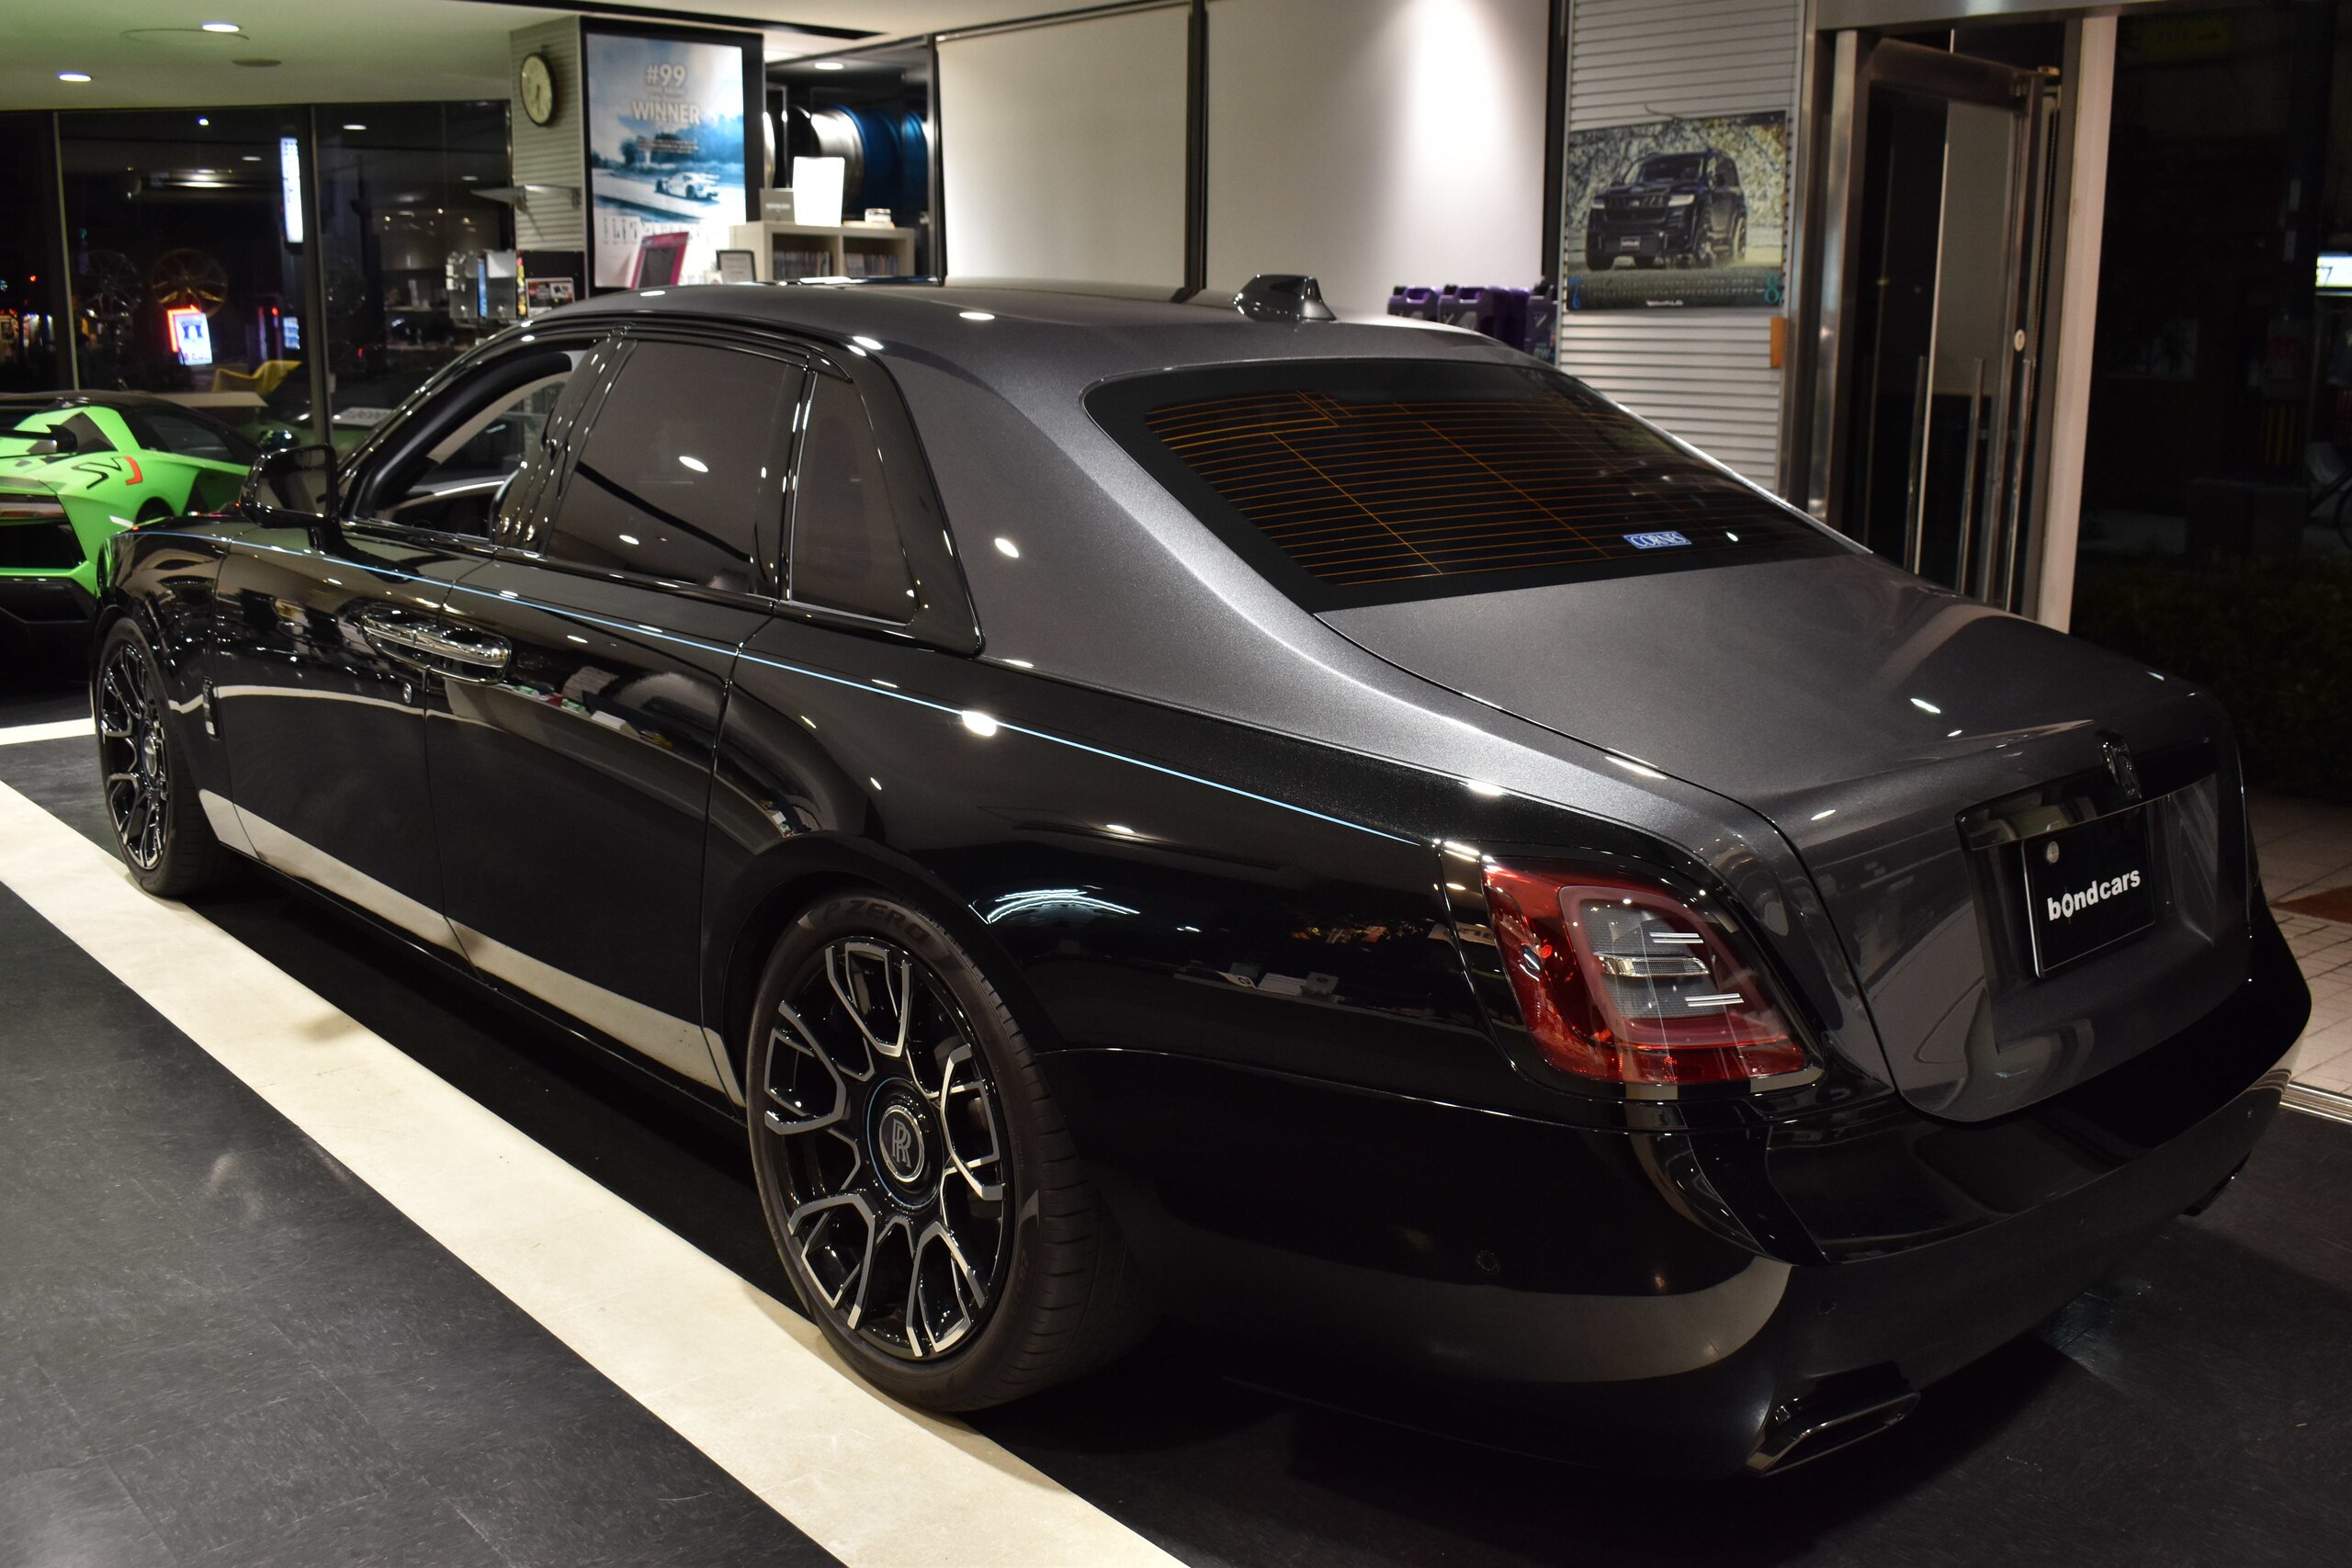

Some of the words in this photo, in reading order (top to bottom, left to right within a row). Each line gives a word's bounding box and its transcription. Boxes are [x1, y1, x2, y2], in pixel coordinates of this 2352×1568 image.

[646, 63, 686, 87] #99
[632, 100, 701, 125] WINNER
[1763, 272, 1781, 304] 8
[845, 900, 931, 944] ZERO
